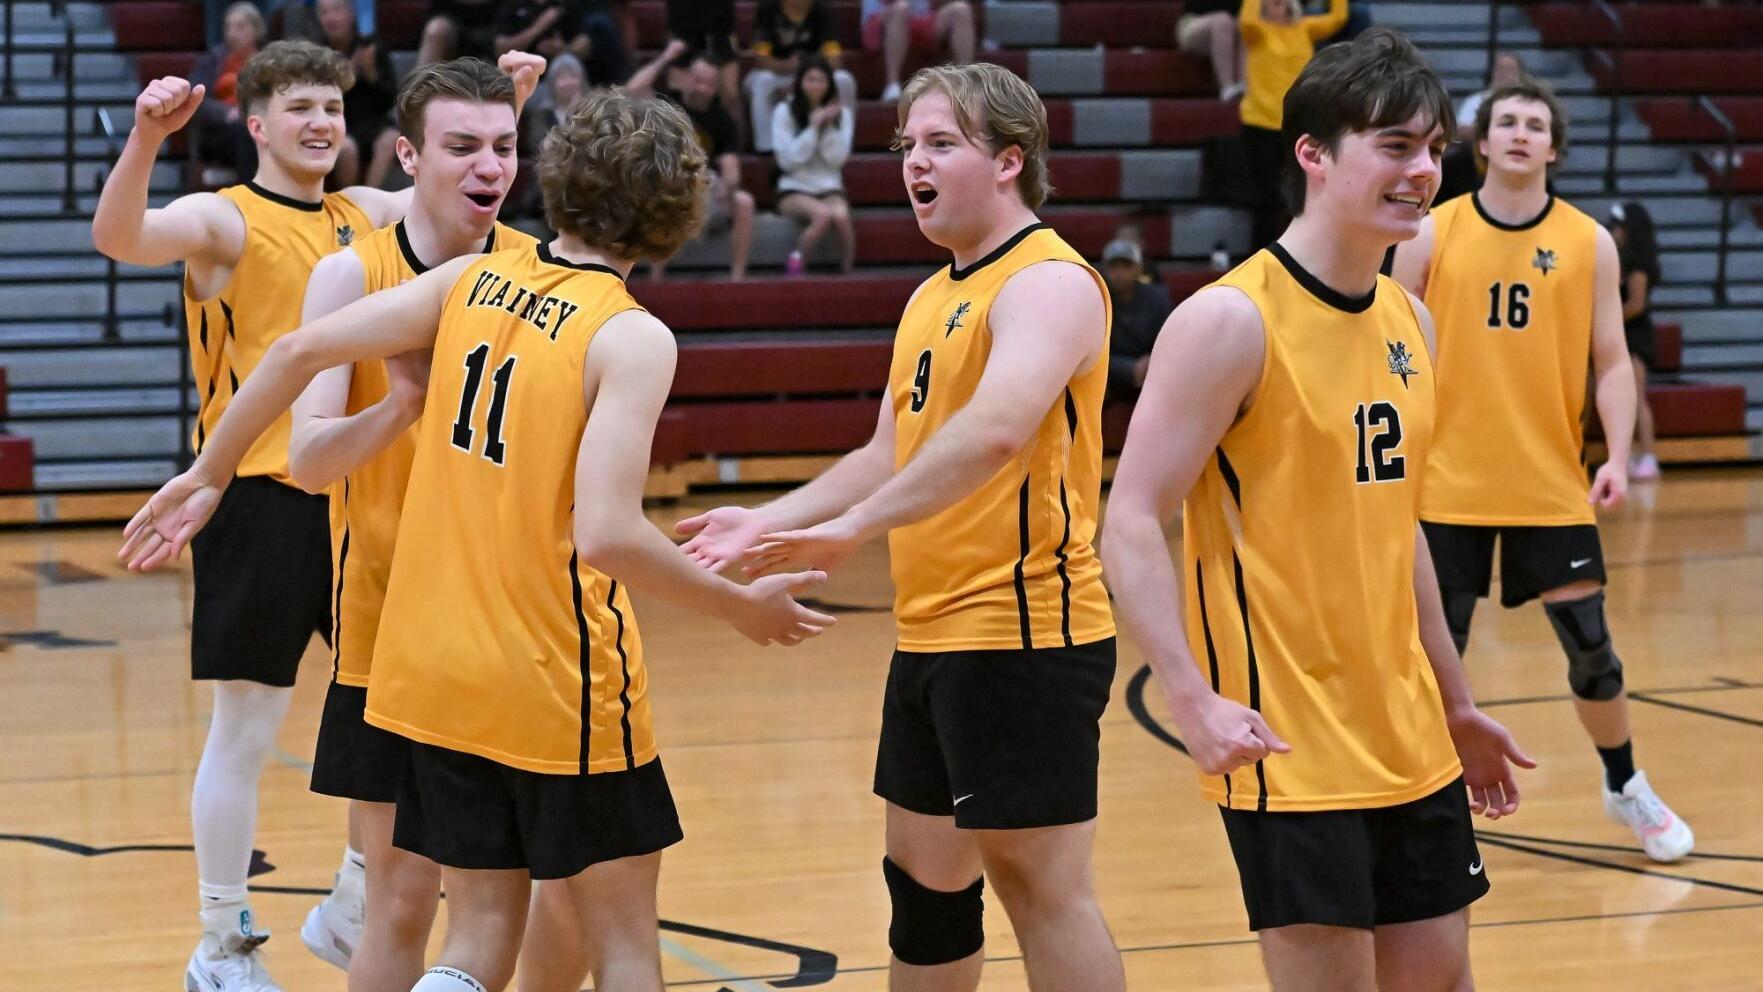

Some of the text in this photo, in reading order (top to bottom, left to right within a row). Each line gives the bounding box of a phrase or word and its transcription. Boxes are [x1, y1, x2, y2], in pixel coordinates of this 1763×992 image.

[466, 270, 578, 341] VIAINEY
[1486, 281, 1531, 330] 16
[450, 341, 517, 467] 11
[911, 348, 932, 414] 9
[1353, 401, 1405, 483] 12
